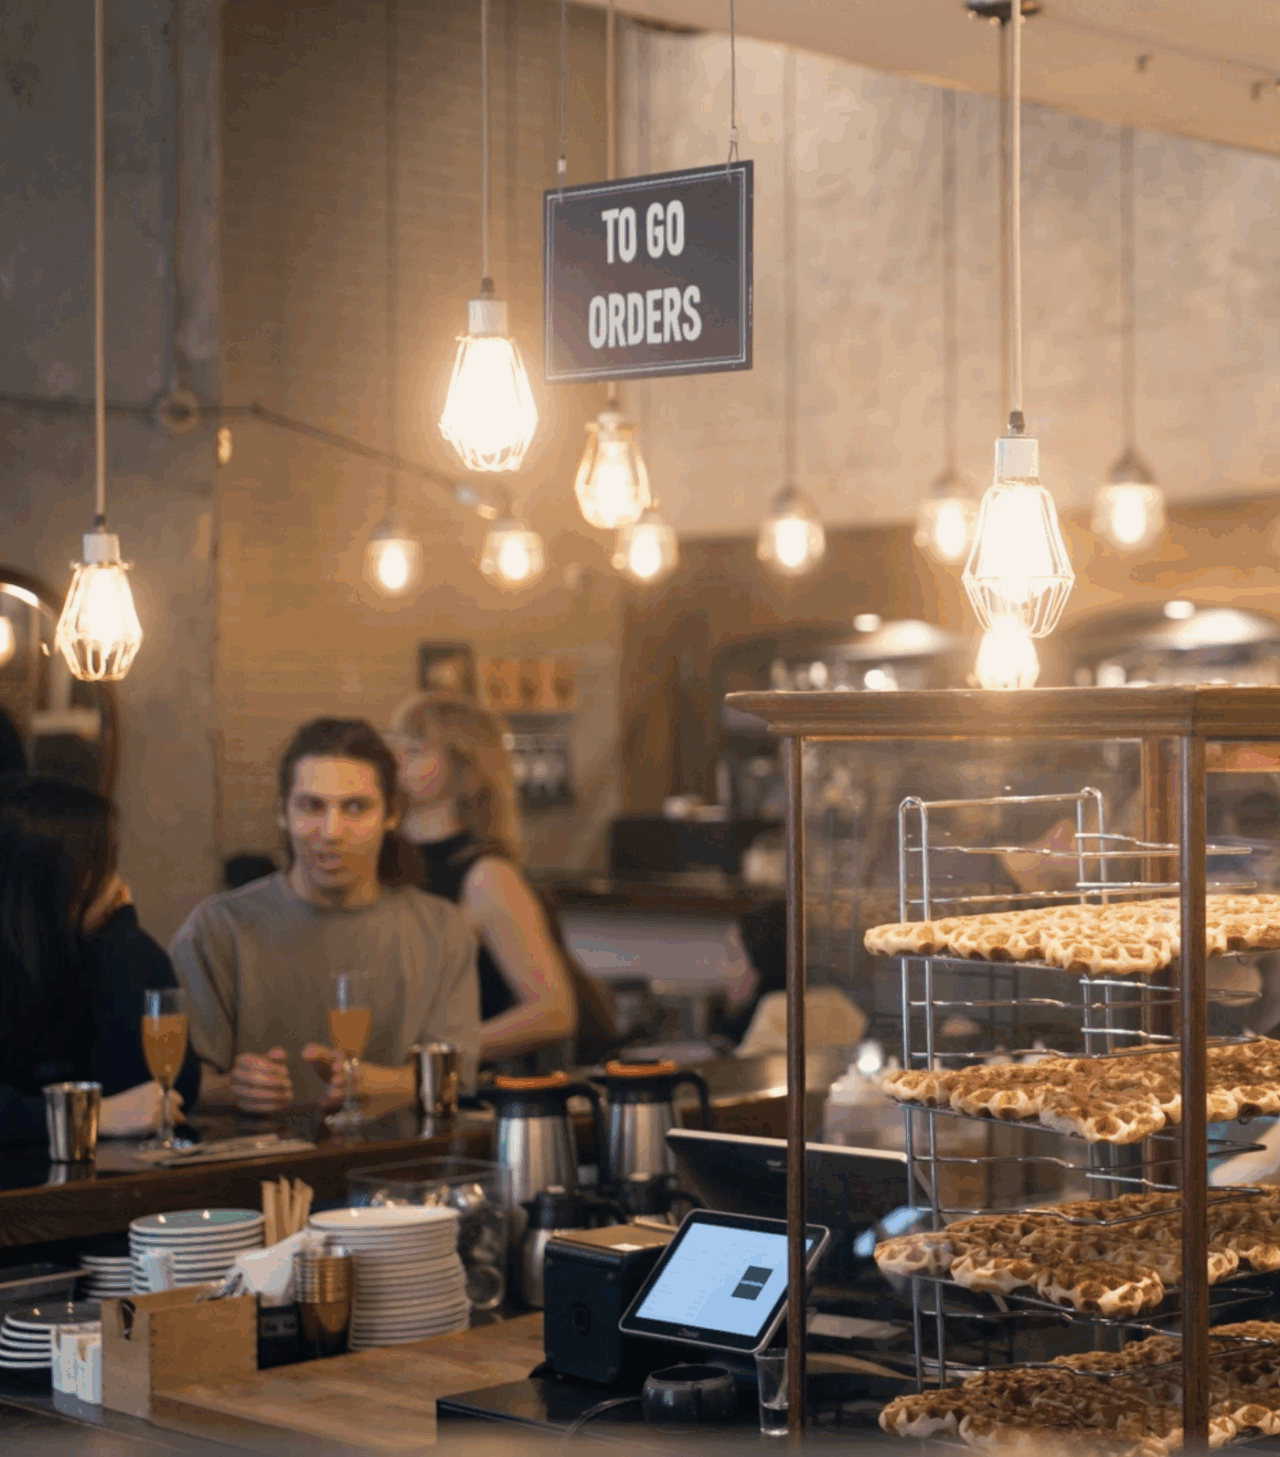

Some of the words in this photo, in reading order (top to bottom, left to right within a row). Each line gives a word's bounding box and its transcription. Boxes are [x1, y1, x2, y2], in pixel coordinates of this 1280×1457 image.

[601, 206, 637, 264] TO
[645, 199, 685, 259] GO
[587, 284, 703, 350] ORDERS
